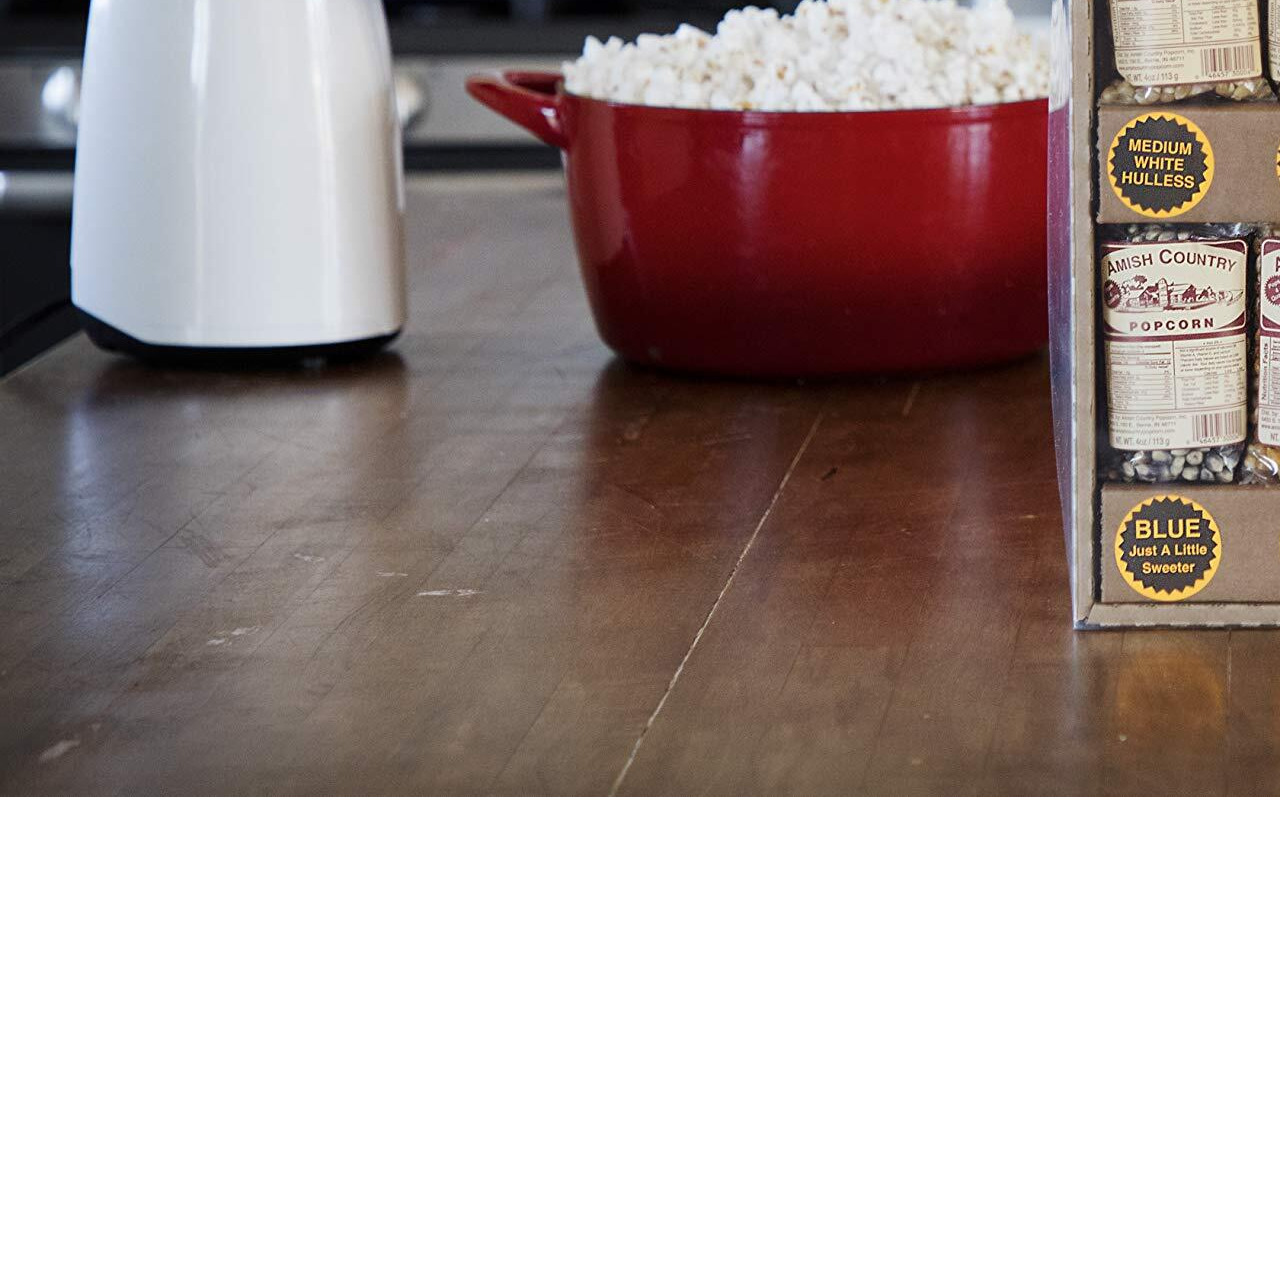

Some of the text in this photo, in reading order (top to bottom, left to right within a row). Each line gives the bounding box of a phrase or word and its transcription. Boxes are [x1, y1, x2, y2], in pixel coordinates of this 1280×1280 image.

[1160, 72, 1173, 81] 113
[1128, 138, 1192, 156] MEDIUM
[1134, 156, 1184, 172] WHITE
[1122, 171, 1195, 188] HULLESS
[1108, 249, 1237, 276] AMISH COUNTRY
[1130, 318, 1214, 332] POPCORN
[1152, 437, 1164, 445] 113
[1135, 518, 1200, 540] BLUE
[1129, 544, 1208, 558] Just A Little
[1142, 562, 1195, 574] Sweeter
